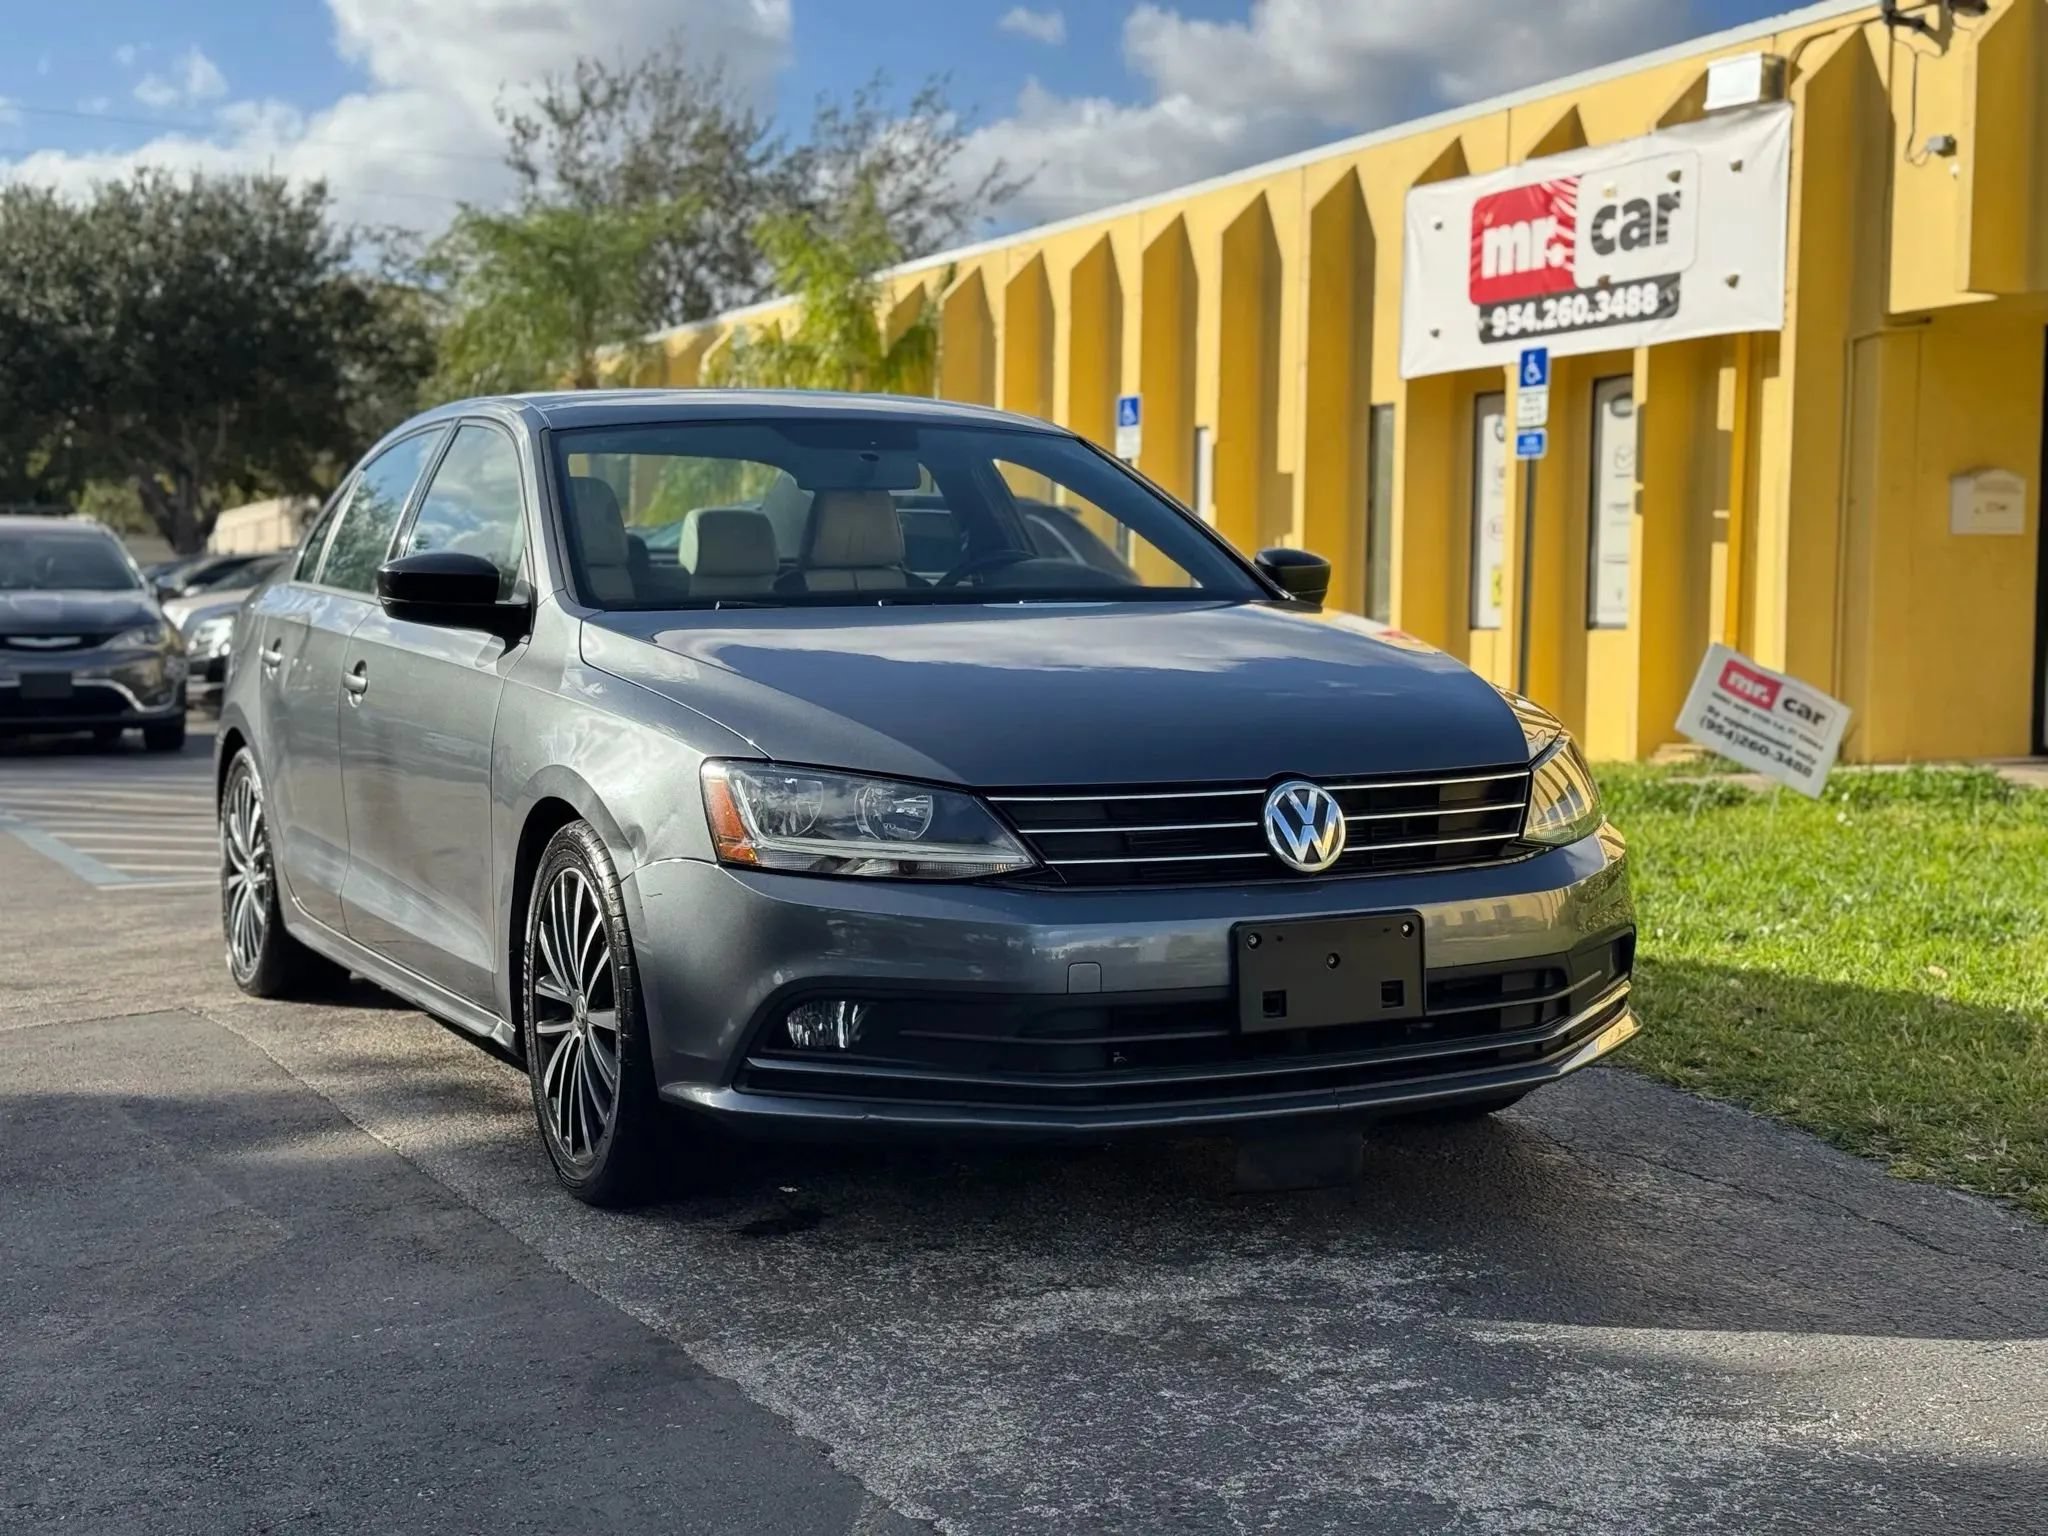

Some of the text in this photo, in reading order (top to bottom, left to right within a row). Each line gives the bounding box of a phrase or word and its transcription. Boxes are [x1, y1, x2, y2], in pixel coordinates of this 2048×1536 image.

[1482, 190, 1681, 279] mr. car
[1491, 282, 1659, 337] 954.260.3488
[1783, 697, 1825, 725] car
